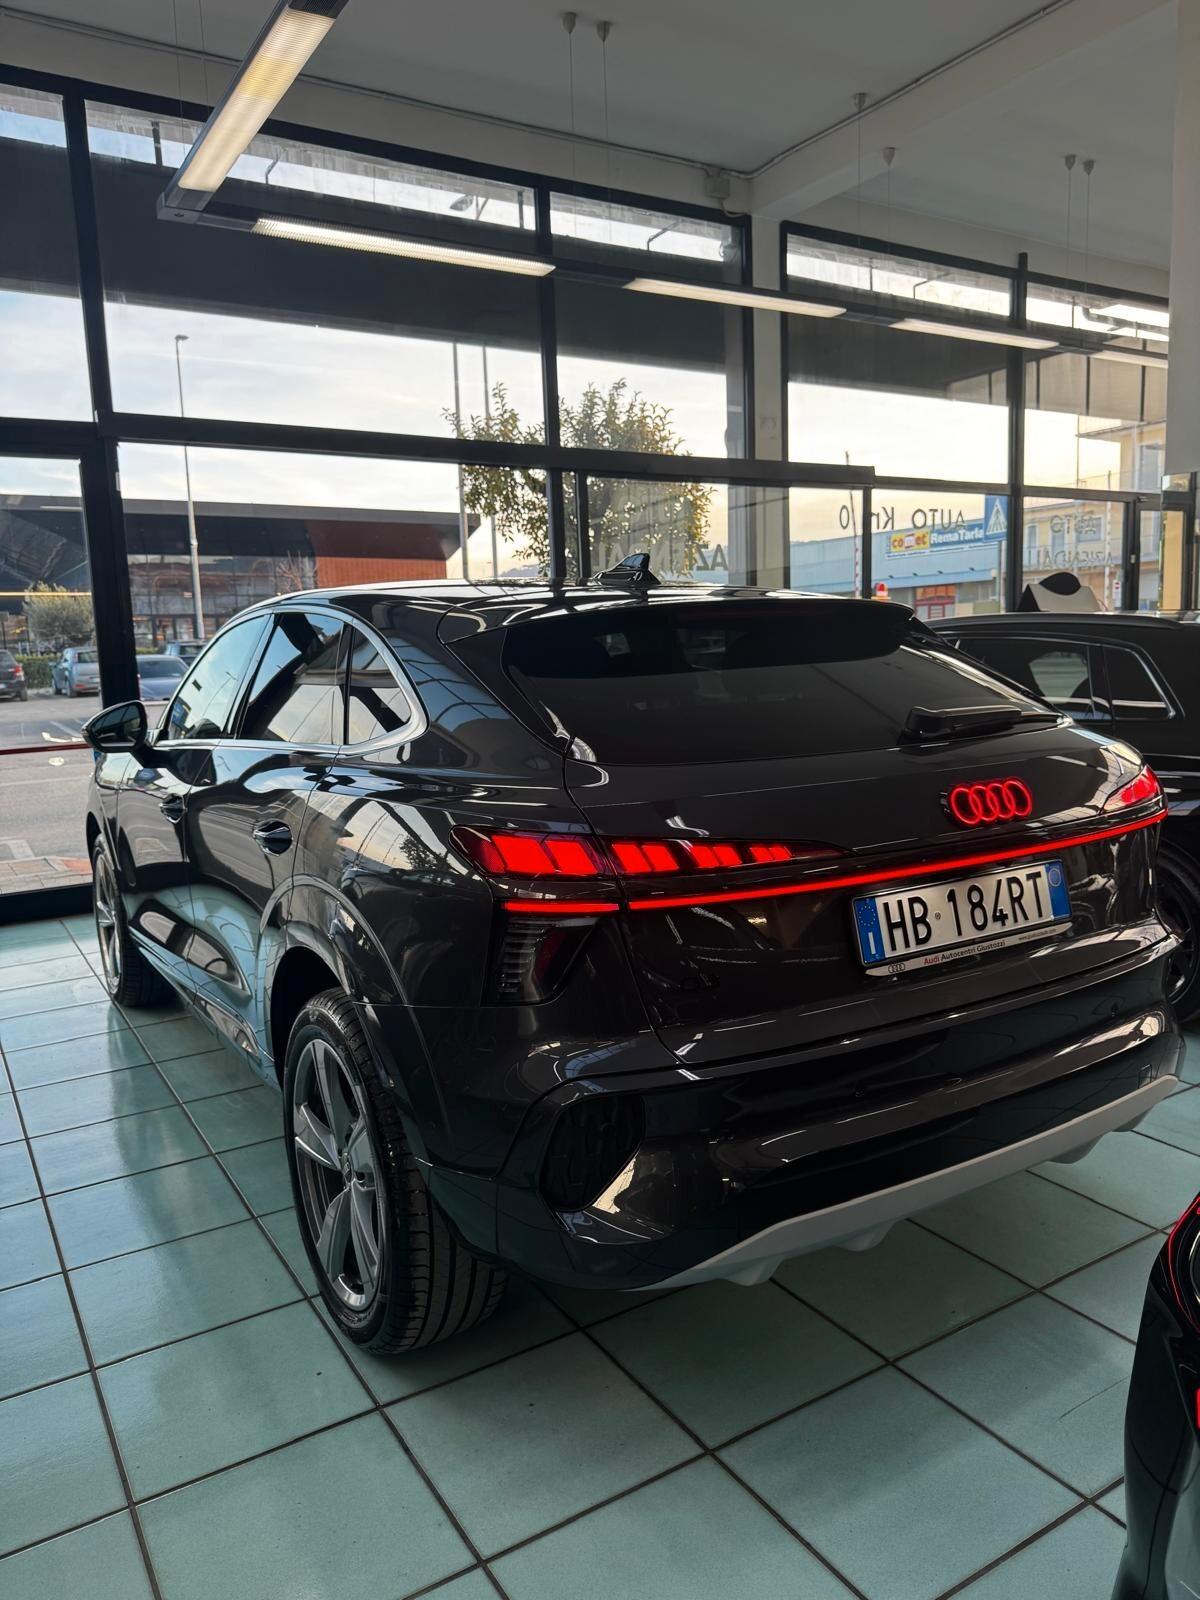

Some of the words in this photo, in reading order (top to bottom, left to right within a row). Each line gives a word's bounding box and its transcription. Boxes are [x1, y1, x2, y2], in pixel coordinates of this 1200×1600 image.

[883, 895, 932, 951] HB
[946, 872, 1042, 937] 184RT
[923, 955, 940, 966] Audi
[940, 947, 975, 961] Autocentri
[976, 940, 1006, 952] Giustozzi
